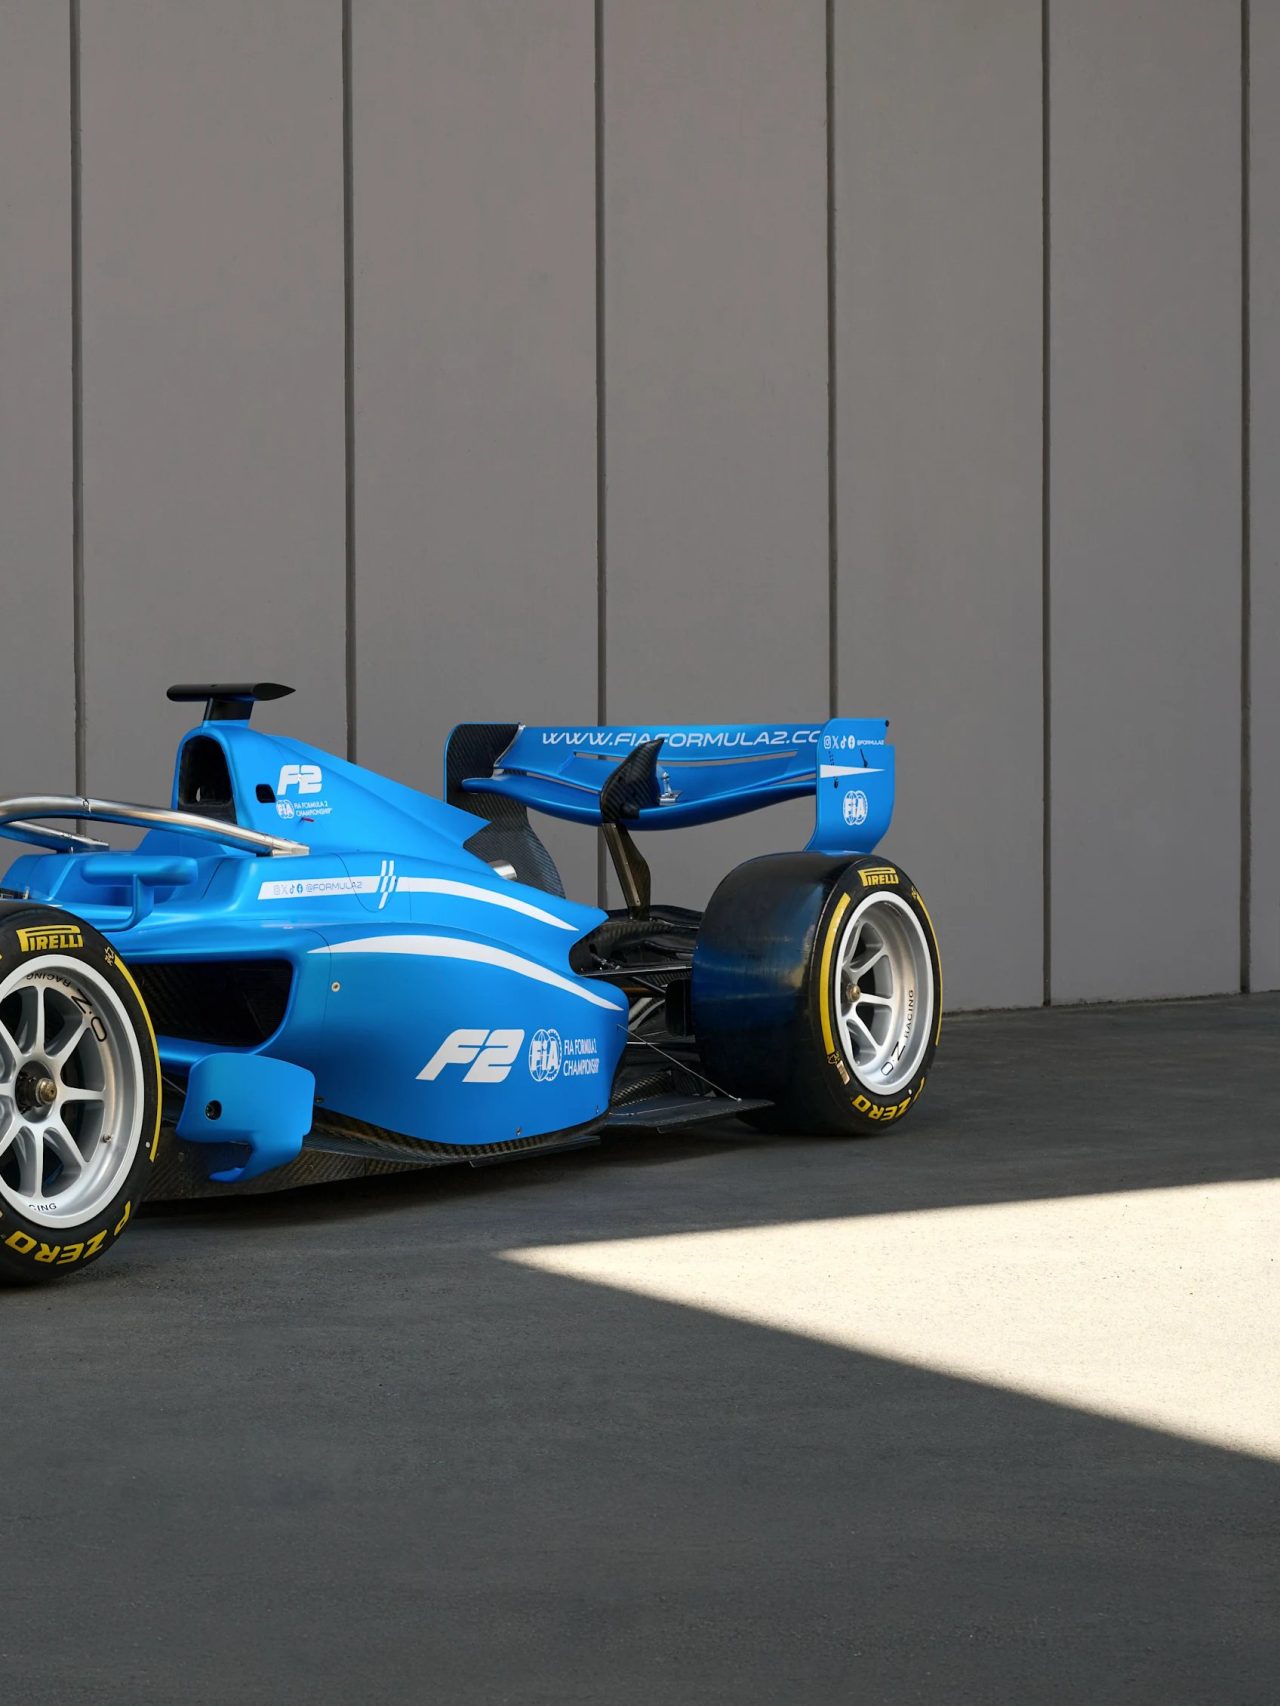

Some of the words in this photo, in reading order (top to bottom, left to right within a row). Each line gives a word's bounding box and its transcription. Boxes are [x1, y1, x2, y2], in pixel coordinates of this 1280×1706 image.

[276, 764, 323, 796] F2
[306, 881, 363, 893] @FORMULA2
[857, 866, 899, 887] PIRELLI
[15, 924, 85, 953] PIRELLI
[26, 972, 72, 988] RACING
[415, 1028, 526, 1083] F2
[563, 1039, 575, 1056] FIA
[575, 1038, 594, 1055] FORMULA
[851, 1094, 912, 1122] ZERO
[4, 1229, 108, 1265] ZERO
